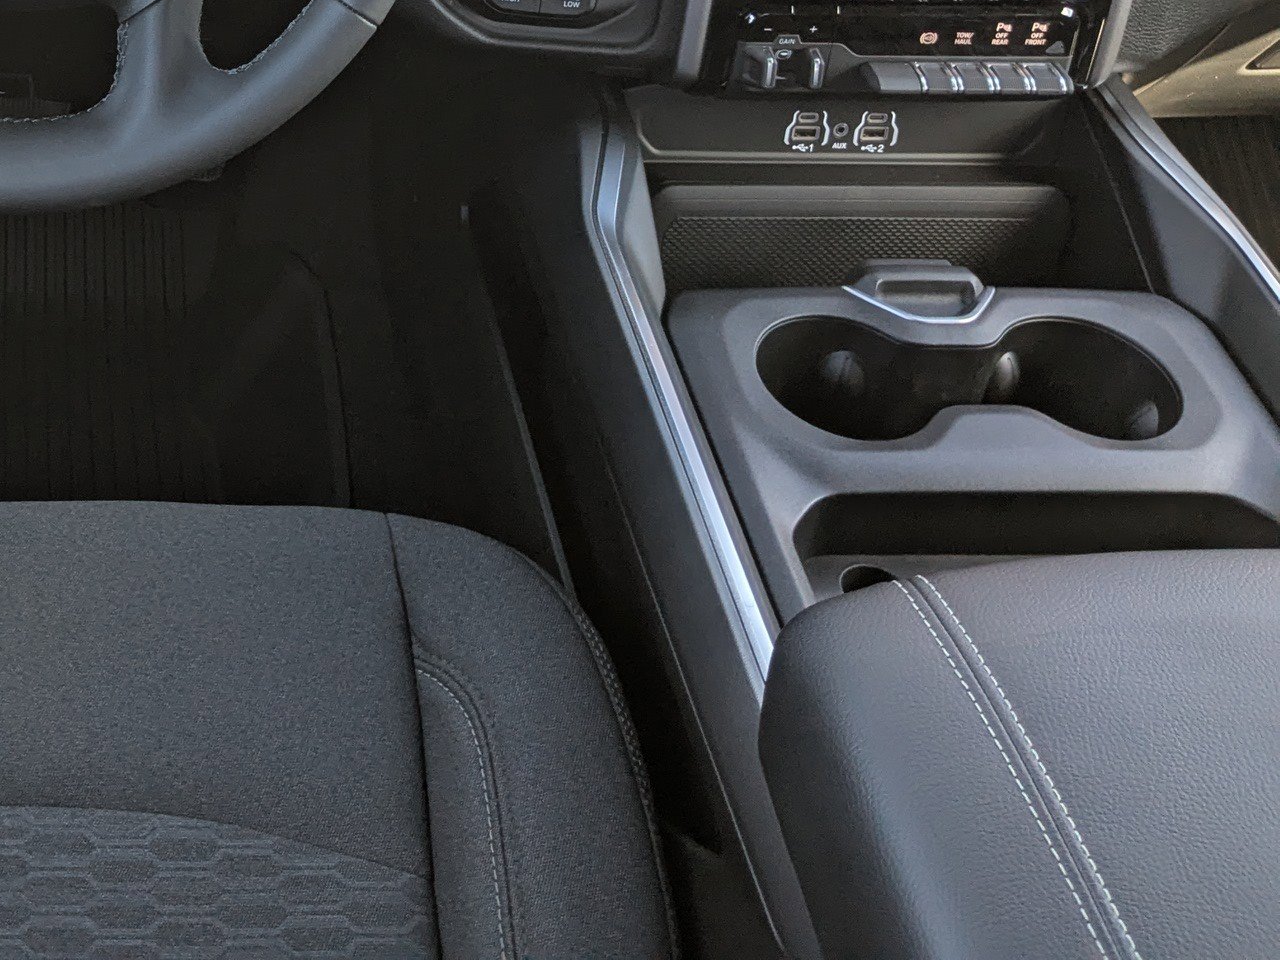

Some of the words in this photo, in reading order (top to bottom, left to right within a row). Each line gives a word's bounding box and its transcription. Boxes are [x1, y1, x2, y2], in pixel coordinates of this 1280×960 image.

[991, 38, 1009, 46] REAR
[1024, 38, 1047, 46] FRONT
[808, 144, 814, 152] 1
[876, 144, 885, 152] 2
